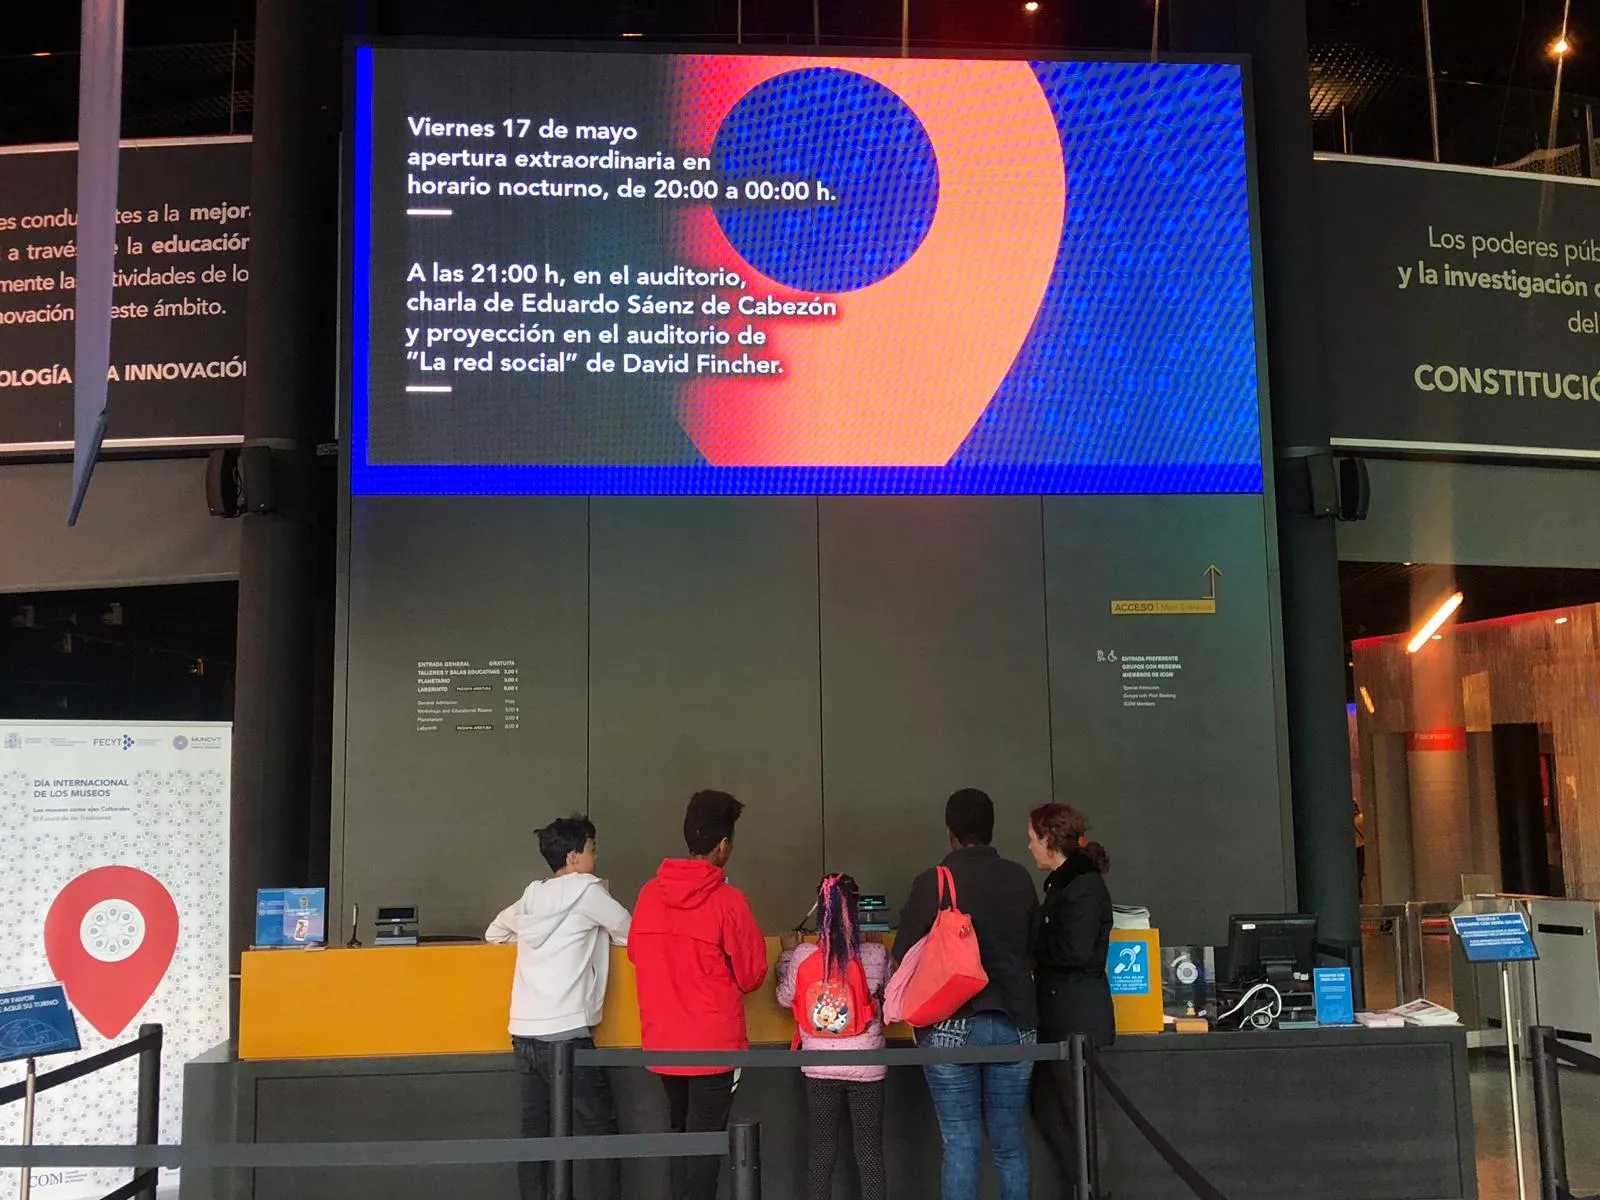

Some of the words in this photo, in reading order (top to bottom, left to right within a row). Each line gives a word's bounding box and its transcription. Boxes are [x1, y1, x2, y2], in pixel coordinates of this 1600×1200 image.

[407, 116, 495, 138] Viernes
[502, 119, 531, 138] 17
[538, 119, 569, 139] de
[575, 123, 638, 146] mayo
[407, 150, 507, 174] apertura
[514, 150, 676, 171] extraordinaria
[682, 155, 711, 171] en
[407, 175, 491, 197] horario
[498, 179, 609, 201] nocturno,
[617, 178, 646, 198] de
[654, 180, 718, 200] 20:00
[725, 185, 738, 200] a
[744, 181, 810, 201] 00:00
[816, 181, 837, 202] h.
[147, 209, 158, 223] a
[164, 203, 180, 222] la
[190, 201, 251, 225] mejor
[8, 247, 20, 261] a
[26, 239, 77, 260] travé
[127, 236, 143, 255] la
[1428, 225, 1466, 250] Los
[1472, 231, 1559, 259] poderes
[60, 270, 77, 291] la
[201, 263, 227, 284] de
[406, 264, 427, 282] A
[433, 262, 464, 283] las
[471, 264, 538, 284] 21:00
[544, 265, 566, 288] h,
[573, 271, 601, 286] en
[609, 265, 630, 286] el
[636, 266, 747, 290] auditorio,
[1397, 266, 1412, 289] y
[1418, 260, 1438, 285] la
[1444, 263, 1588, 298] investigación
[111, 302, 149, 319] este
[153, 296, 227, 318] ámbito.
[406, 291, 477, 312] charla
[484, 292, 514, 312] de
[522, 293, 620, 314] Eduardo
[626, 294, 695, 315] Sáenz
[701, 295, 731, 315] de
[738, 294, 836, 316] Cabezón
[1567, 310, 1600, 334] del
[405, 328, 419, 347] y
[427, 321, 555, 349] proyección
[562, 328, 591, 343] en
[598, 323, 619, 344] el
[626, 323, 730, 345] auditorio
[737, 324, 767, 345] de
[453, 351, 493, 373] red
[586, 353, 615, 373] de
[623, 354, 690, 374] David
[697, 354, 784, 375] Fincher.
[1114, 603, 1154, 612] ACCESO
[93, 738, 122, 747] FECYT
[33, 790, 47, 798] DE
[71, 789, 111, 797] MUSEOS
[34, 778, 51, 787] DÍA
[53, 778, 129, 787] INTERNACIONAL
[11, 994, 35, 1003] FAVOR
[22, 1002, 33, 1010] SU
[33, 998, 59, 1008] TURNO
